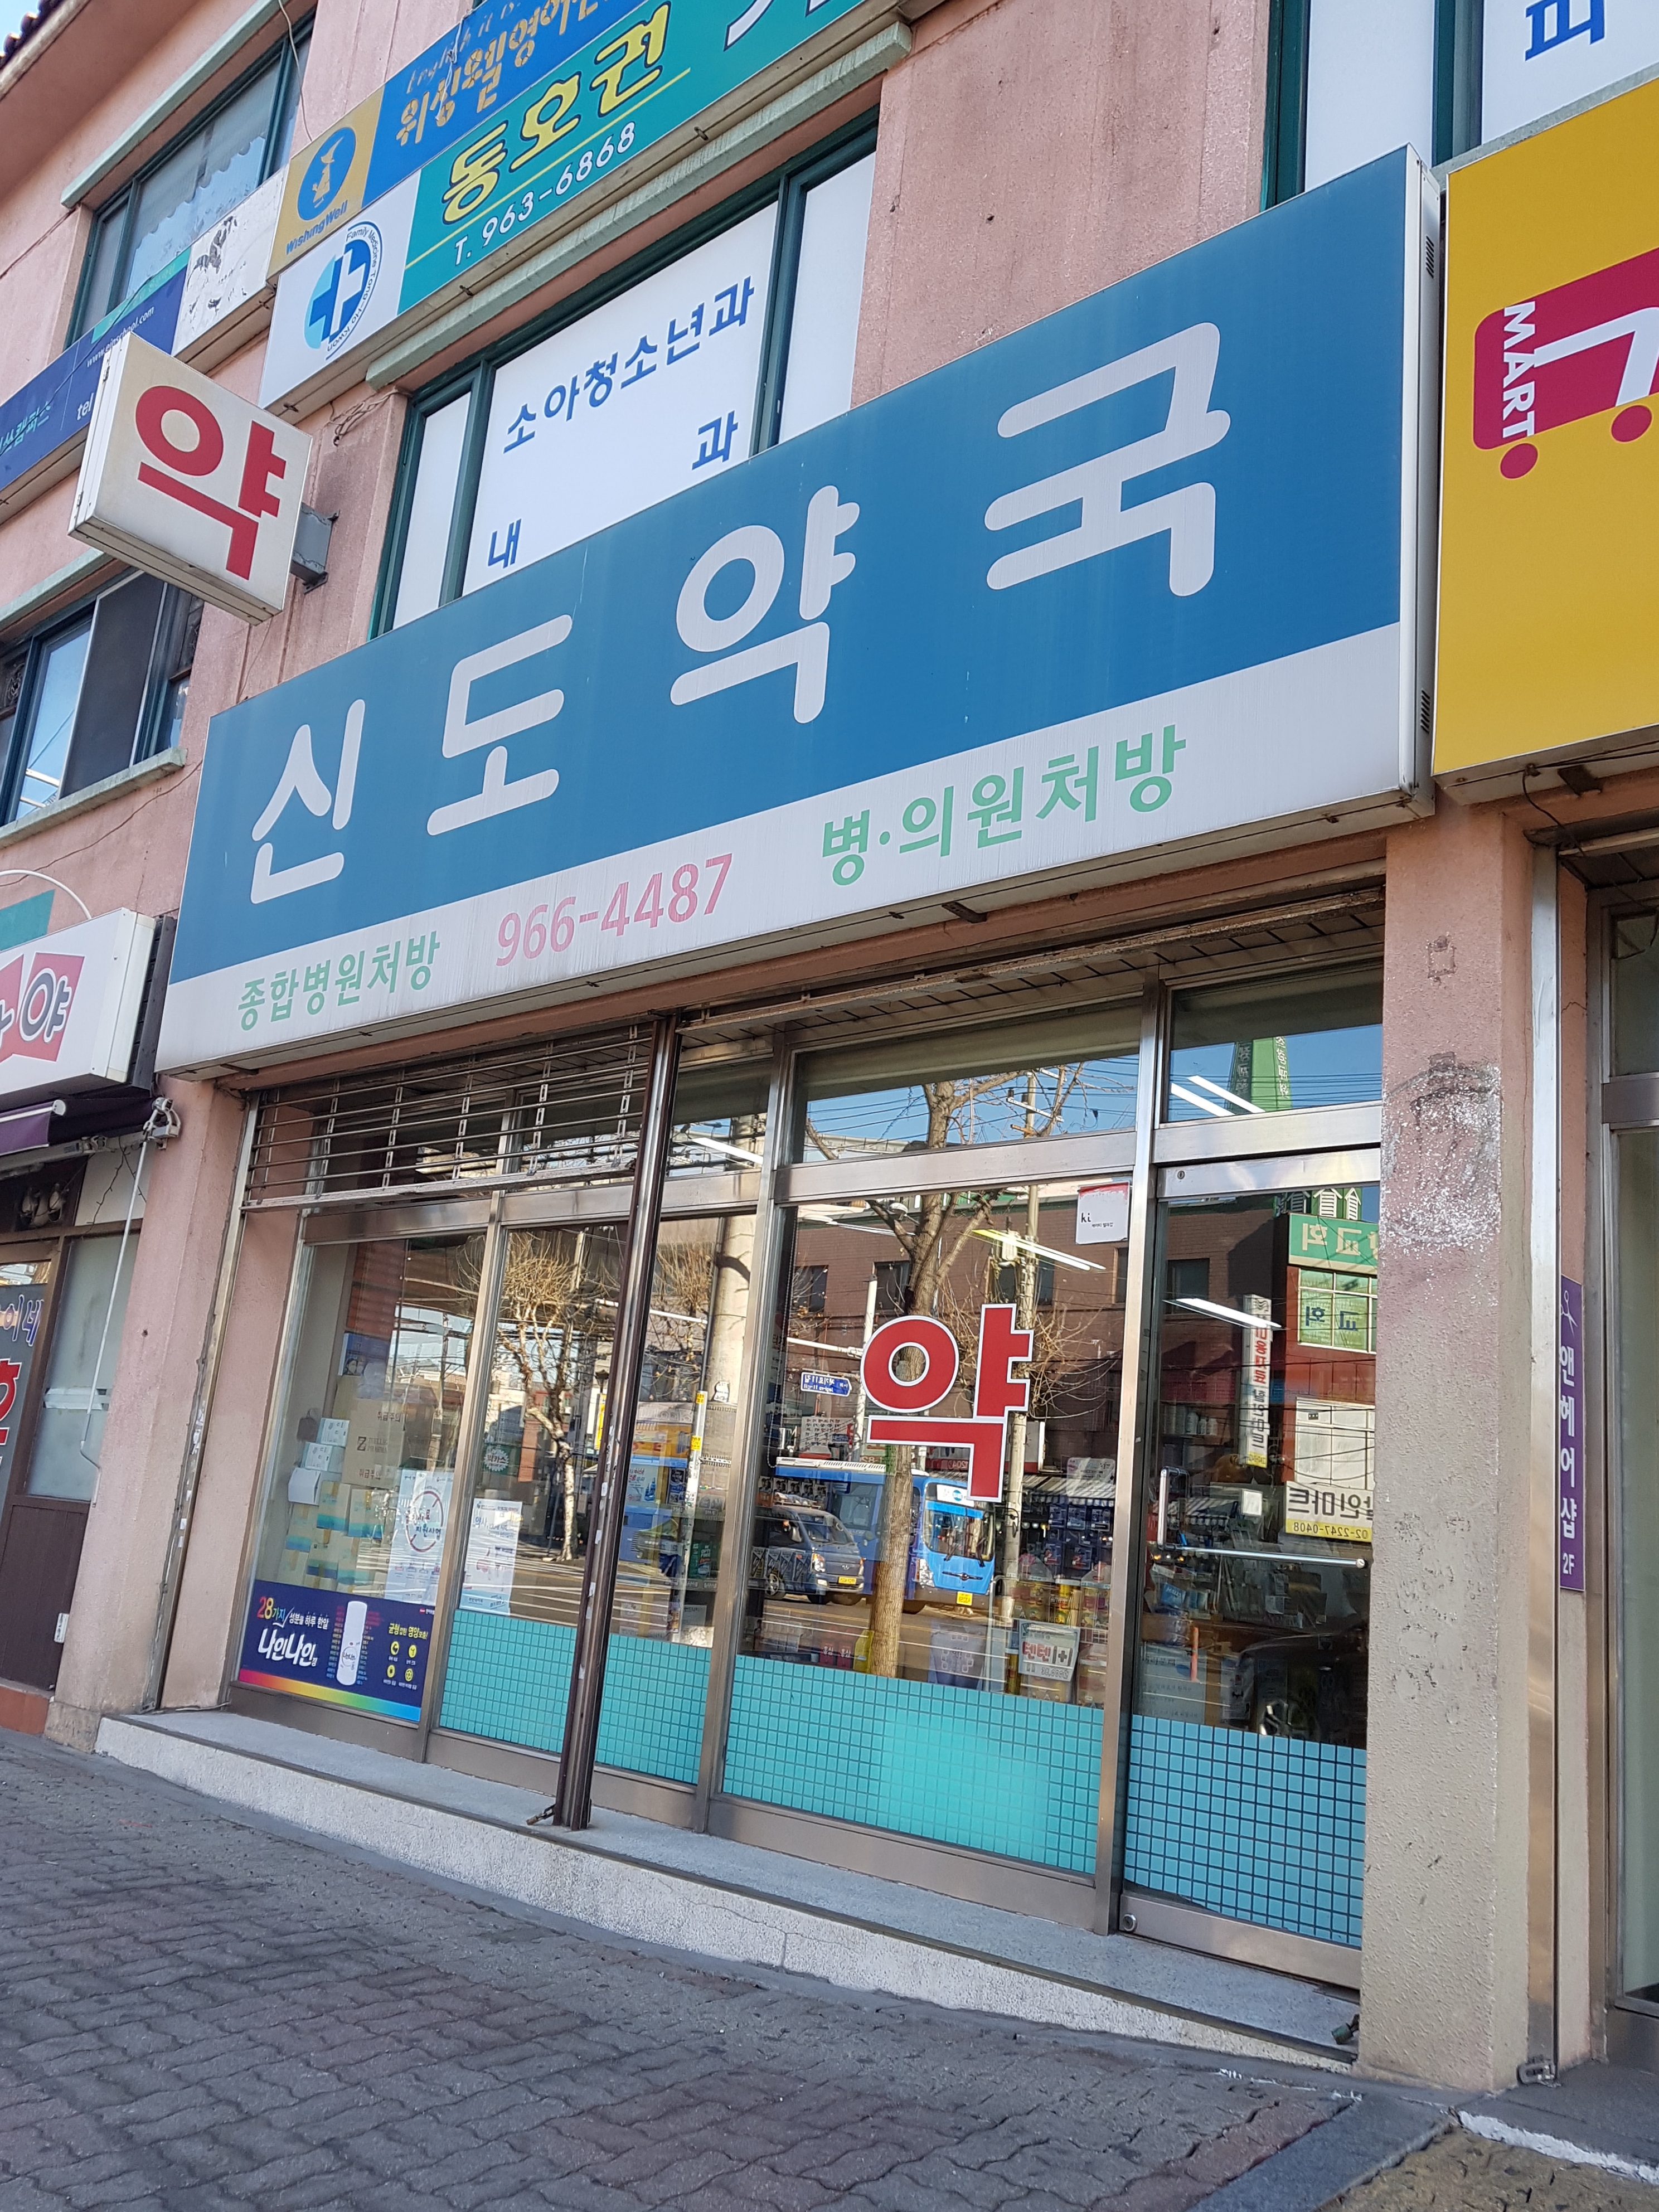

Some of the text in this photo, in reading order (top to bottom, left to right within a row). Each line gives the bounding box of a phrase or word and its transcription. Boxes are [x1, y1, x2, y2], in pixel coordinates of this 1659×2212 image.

[482, 121, 636, 248] 963-6868
[346, 226, 368, 242] Family
[368, 229, 379, 268] Medicine
[76, 392, 94, 422] tel
[503, 275, 754, 454] 소아청소년과
[1502, 300, 1536, 439] MART
[135, 385, 287, 581] 약
[251, 322, 1231, 904] 신도약국
[496, 853, 733, 966] 966-4487
[238, 930, 440, 1031] 종합병원처방
[377, 1411, 402, 1422] 취급주의
[860, 1303, 1035, 1503] 약
[1563, 1553, 1575, 1575] 2F
